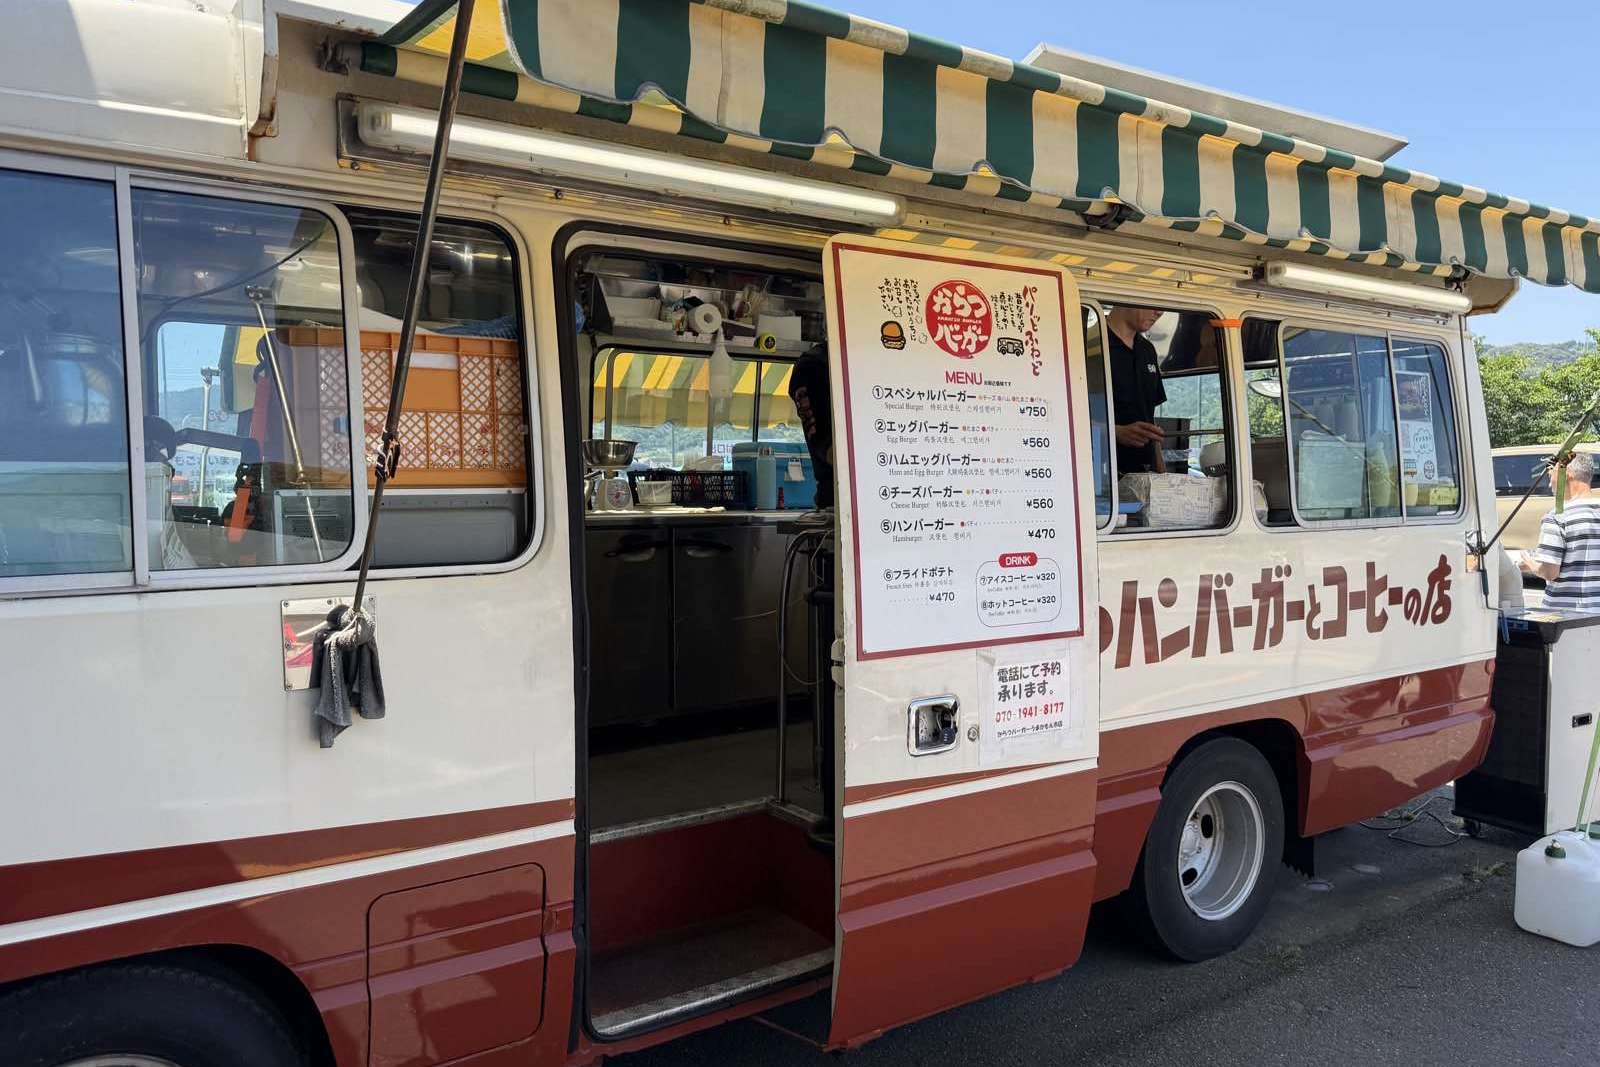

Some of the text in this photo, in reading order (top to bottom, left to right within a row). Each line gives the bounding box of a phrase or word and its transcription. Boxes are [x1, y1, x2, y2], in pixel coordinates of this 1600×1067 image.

[933, 284, 988, 318] からつ
[945, 370, 983, 386] MENU
[884, 402, 924, 412] Special Burger
[1019, 406, 1047, 417] ¥750
[887, 435, 918, 444] Egg Burger
[1022, 437, 1050, 449] ¥560
[927, 469, 944, 477] Burger
[1024, 468, 1052, 479] ¥560
[890, 501, 929, 510] Cheese Burger
[1026, 498, 1053, 509] ¥560
[892, 535, 923, 543] Hamburger
[1027, 528, 1056, 539] ¥470
[1005, 556, 1031, 566] DRINK
[1036, 572, 1056, 582] ¥320
[929, 591, 955, 602] ¥470
[1037, 595, 1057, 604] ¥320
[997, 660, 1062, 683] 電話にて予約
[997, 680, 1054, 702] 承ります。
[995, 702, 1065, 723] 070-1941-8177
